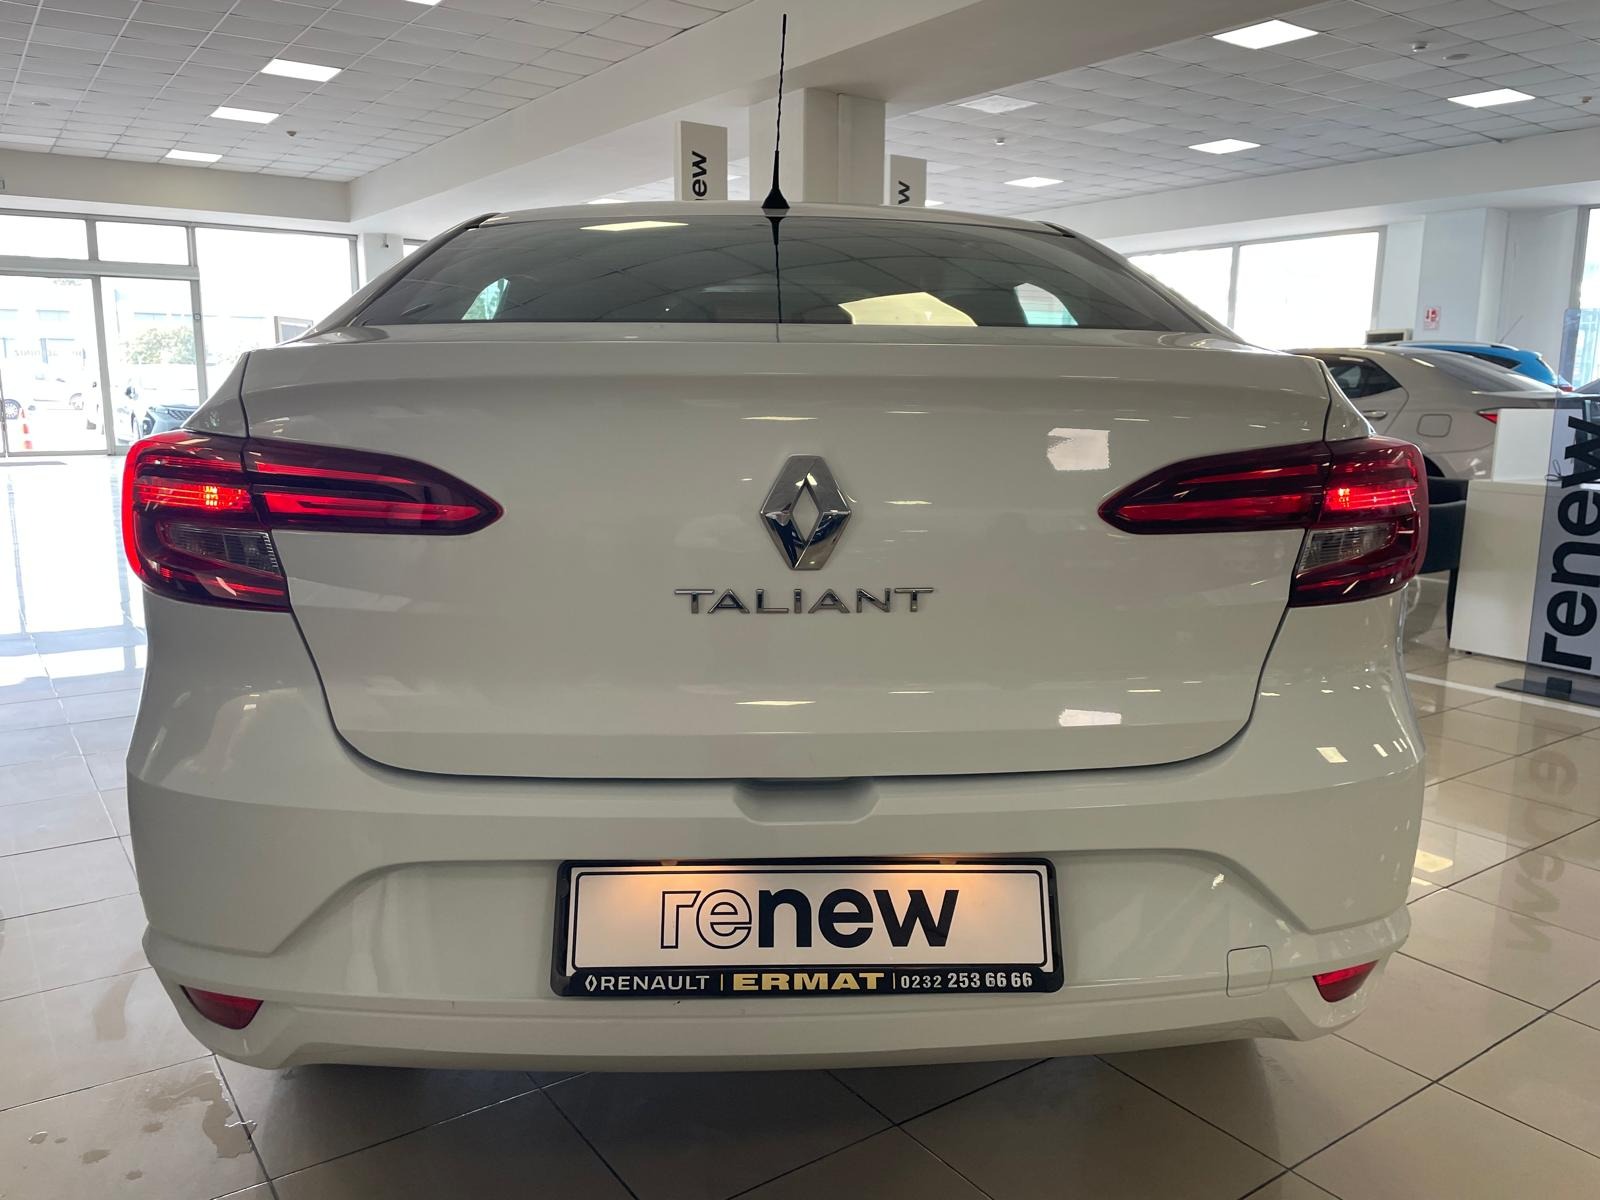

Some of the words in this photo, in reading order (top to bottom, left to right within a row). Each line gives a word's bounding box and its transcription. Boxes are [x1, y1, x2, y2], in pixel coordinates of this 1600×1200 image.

[691, 150, 708, 200] ew
[1541, 415, 1600, 671] renew
[674, 588, 934, 614] TALIANT
[660, 888, 960, 950] renew
[600, 975, 710, 991] RENAULT
[733, 972, 885, 991] ERMAT
[900, 975, 942, 989] 0232
[947, 972, 981, 988] 253
[985, 972, 1007, 988] 66
[1010, 972, 1033, 988] 66
